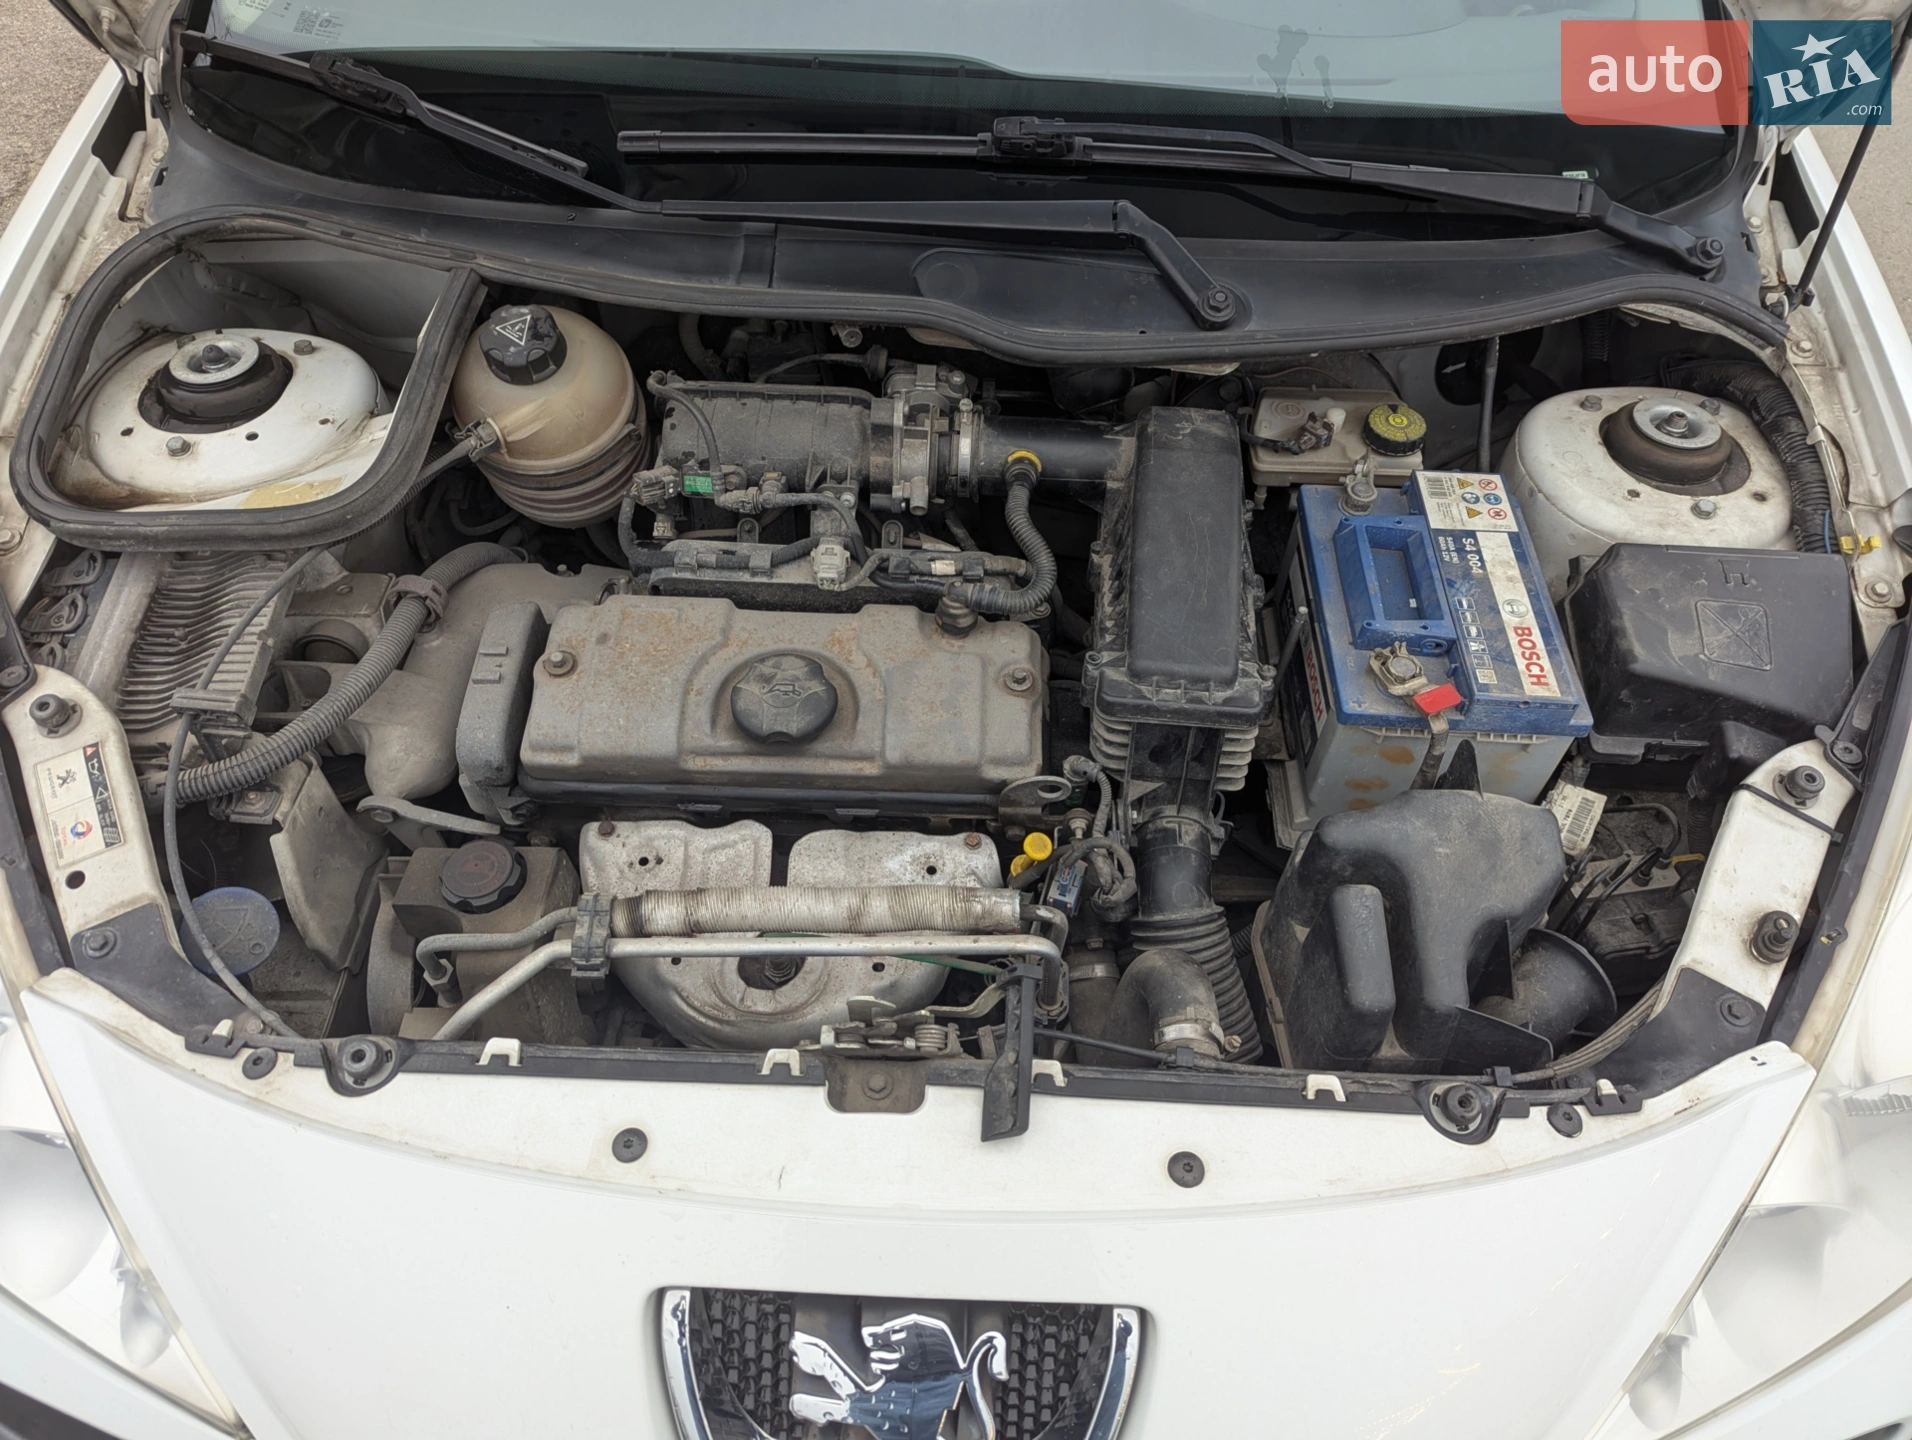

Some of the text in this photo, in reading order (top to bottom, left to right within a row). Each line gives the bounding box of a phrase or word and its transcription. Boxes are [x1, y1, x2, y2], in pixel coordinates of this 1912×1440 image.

[1462, 537, 1483, 574] S4 004
[1513, 625, 1550, 687] BOSCH
[1305, 650, 1324, 719] BOSCH
[46, 767, 58, 799] PEUGEOT
[60, 825, 69, 847] TOTAL
